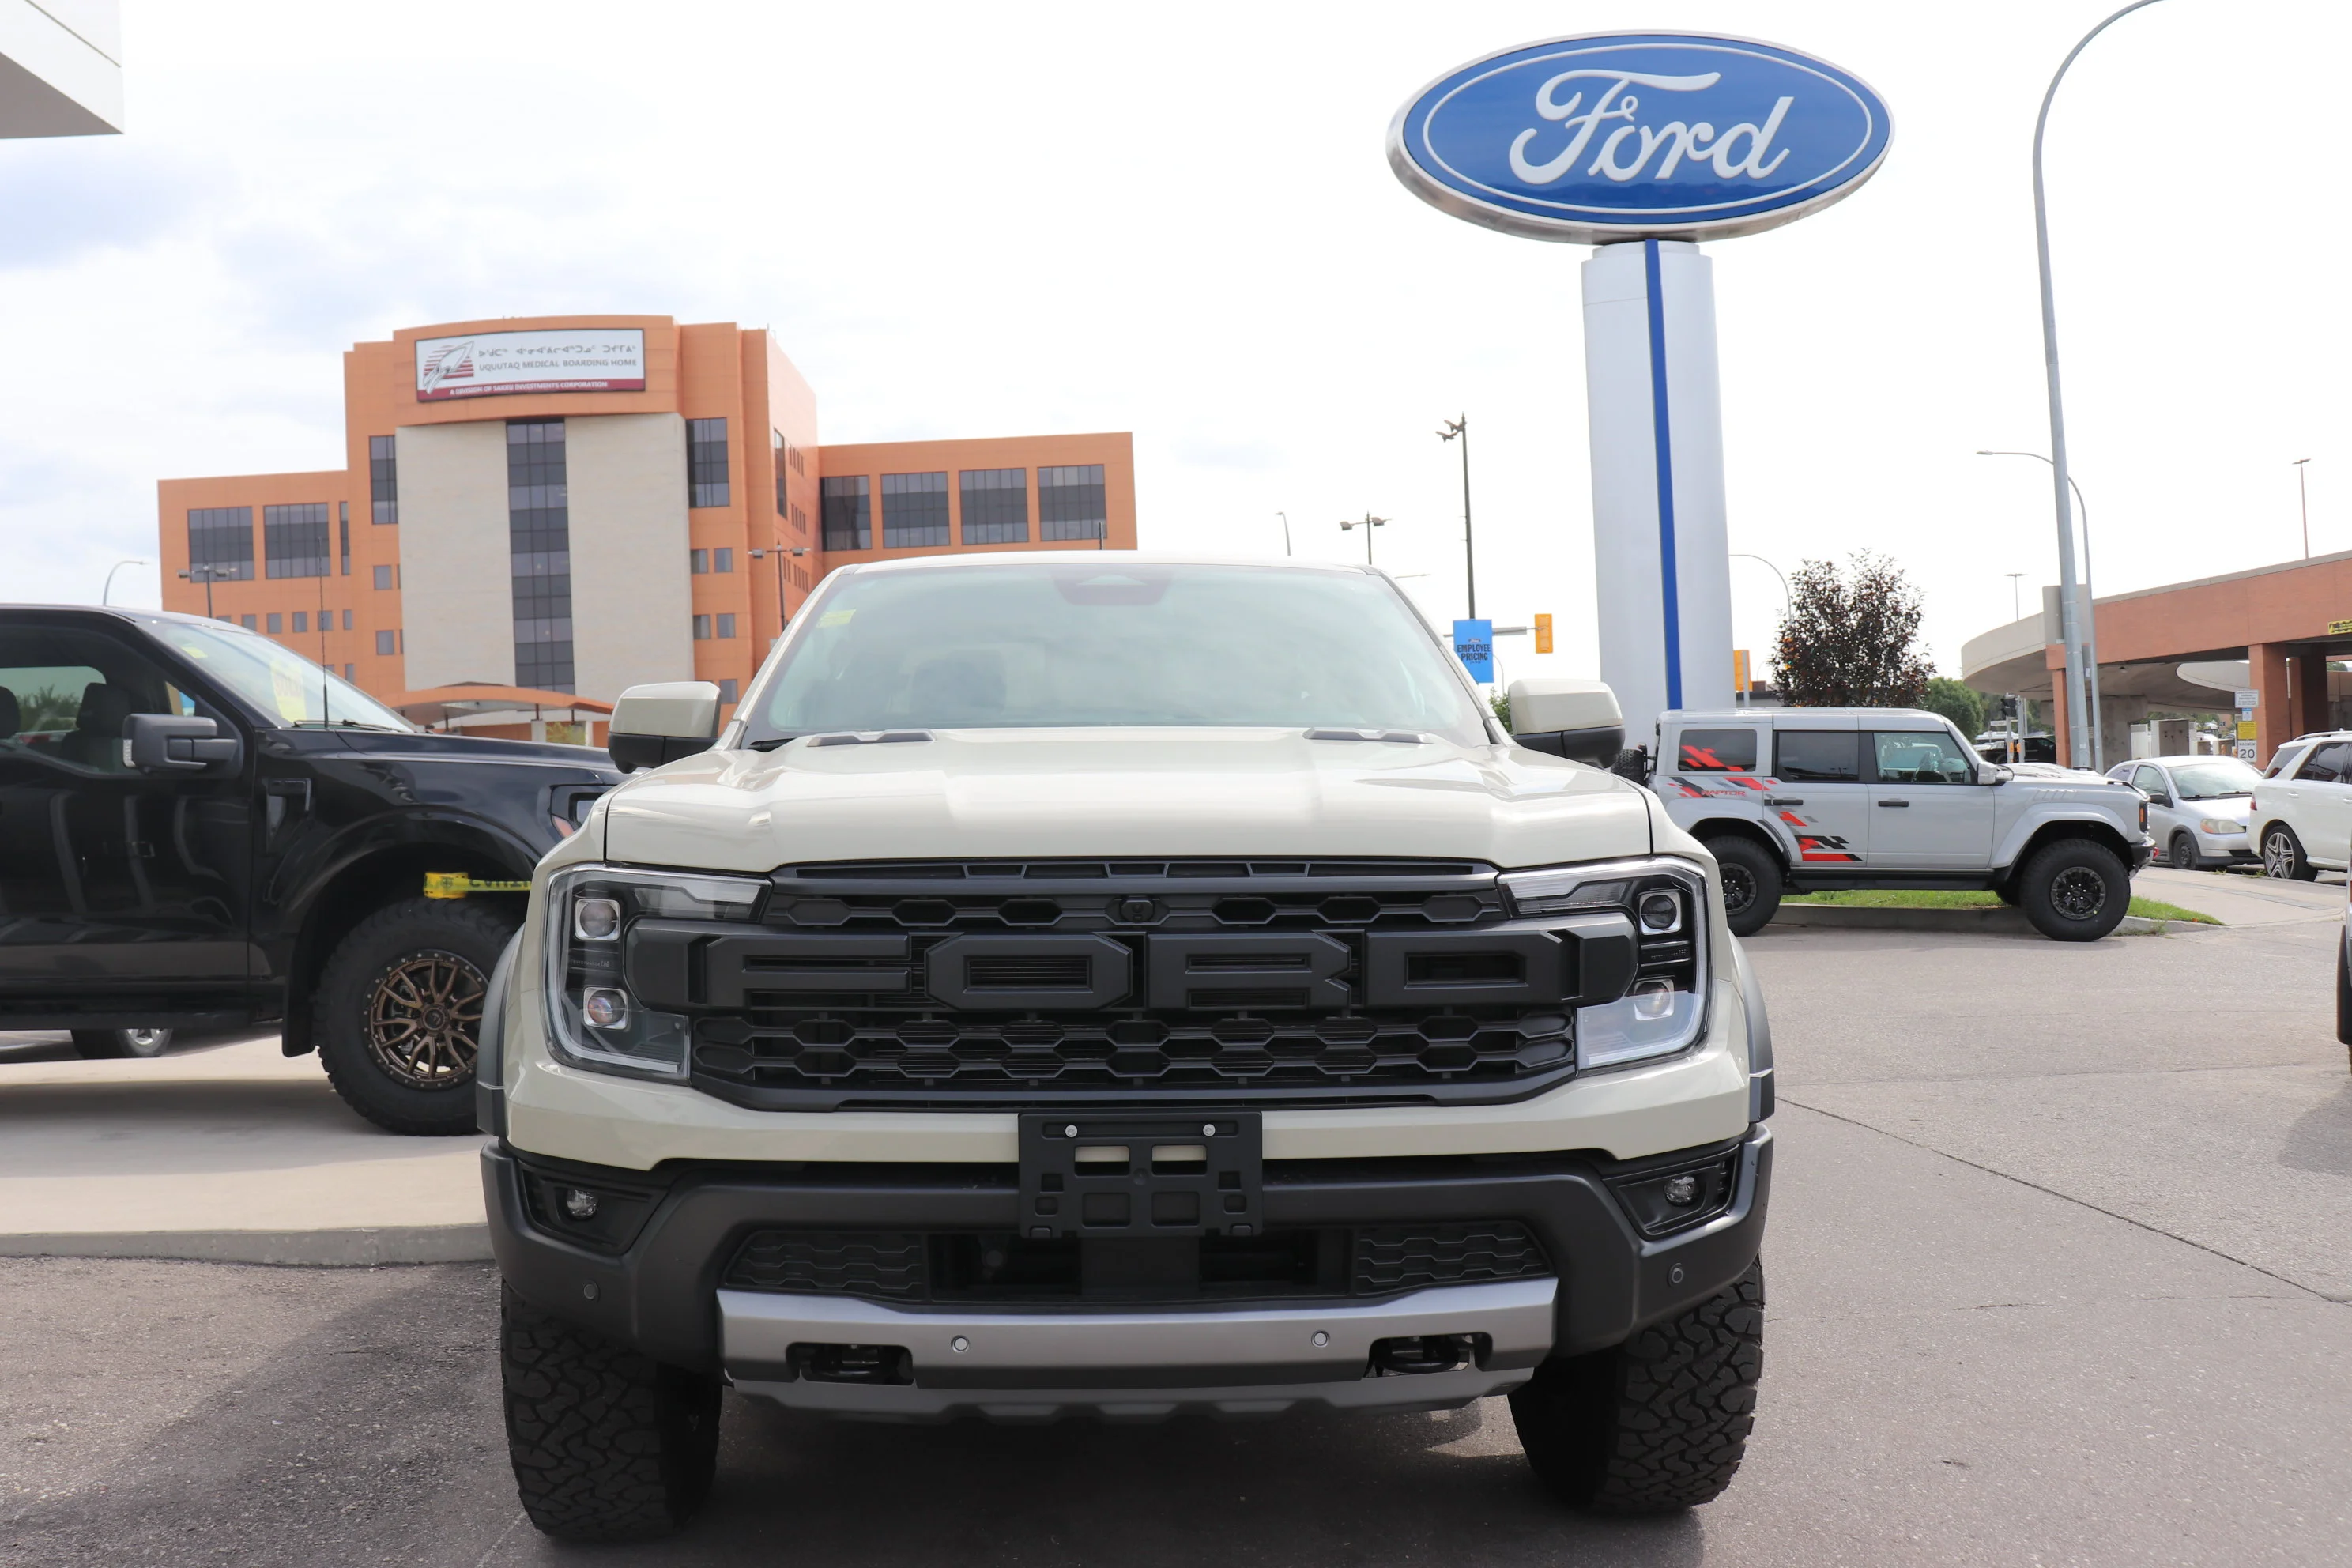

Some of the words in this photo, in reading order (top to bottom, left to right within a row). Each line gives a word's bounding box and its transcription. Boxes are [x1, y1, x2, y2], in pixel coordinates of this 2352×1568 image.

[1509, 69, 1795, 186] Ford
[478, 360, 520, 372] UQUUTAQ
[522, 359, 560, 369] MEDICAL
[562, 358, 609, 368] BOARDING
[610, 358, 638, 368] HOME
[455, 386, 483, 395] DIVISION
[514, 382, 560, 391] INVESTMENTS
[2240, 749, 2255, 759] 20
[706, 933, 1575, 1012] FORD
